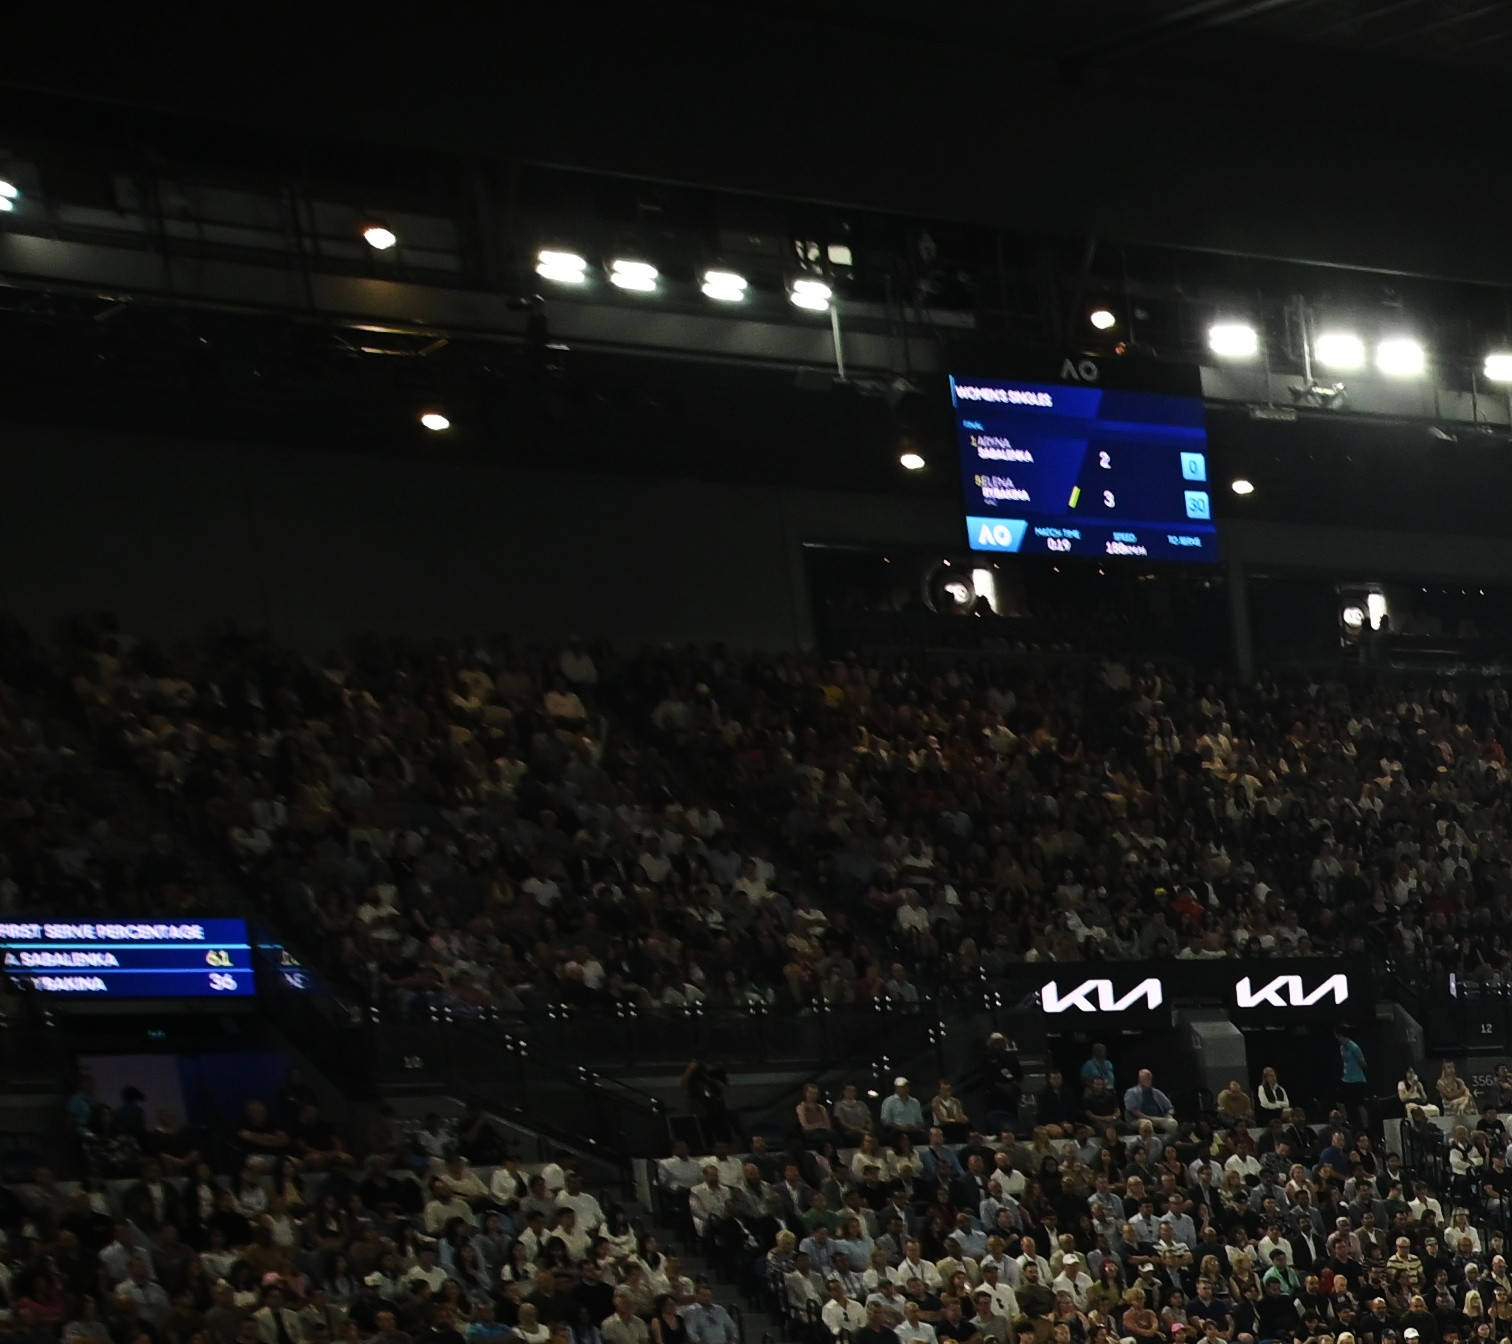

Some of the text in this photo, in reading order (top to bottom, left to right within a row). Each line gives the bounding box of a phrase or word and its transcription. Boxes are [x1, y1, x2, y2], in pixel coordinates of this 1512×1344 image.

[1099, 451, 1111, 469] 2
[1188, 460, 1198, 474] 0
[1103, 490, 1116, 508] 3
[1190, 498, 1205, 513] 30
[977, 524, 1012, 547] AO
[0, 924, 205, 941] FIRST SERVE PERCENTAGE
[205, 950, 235, 967] 61
[208, 972, 238, 991] 36
[1042, 979, 1163, 1013] KIA
[1236, 975, 1349, 1008] KIA
[1481, 1023, 1493, 1034] 12
